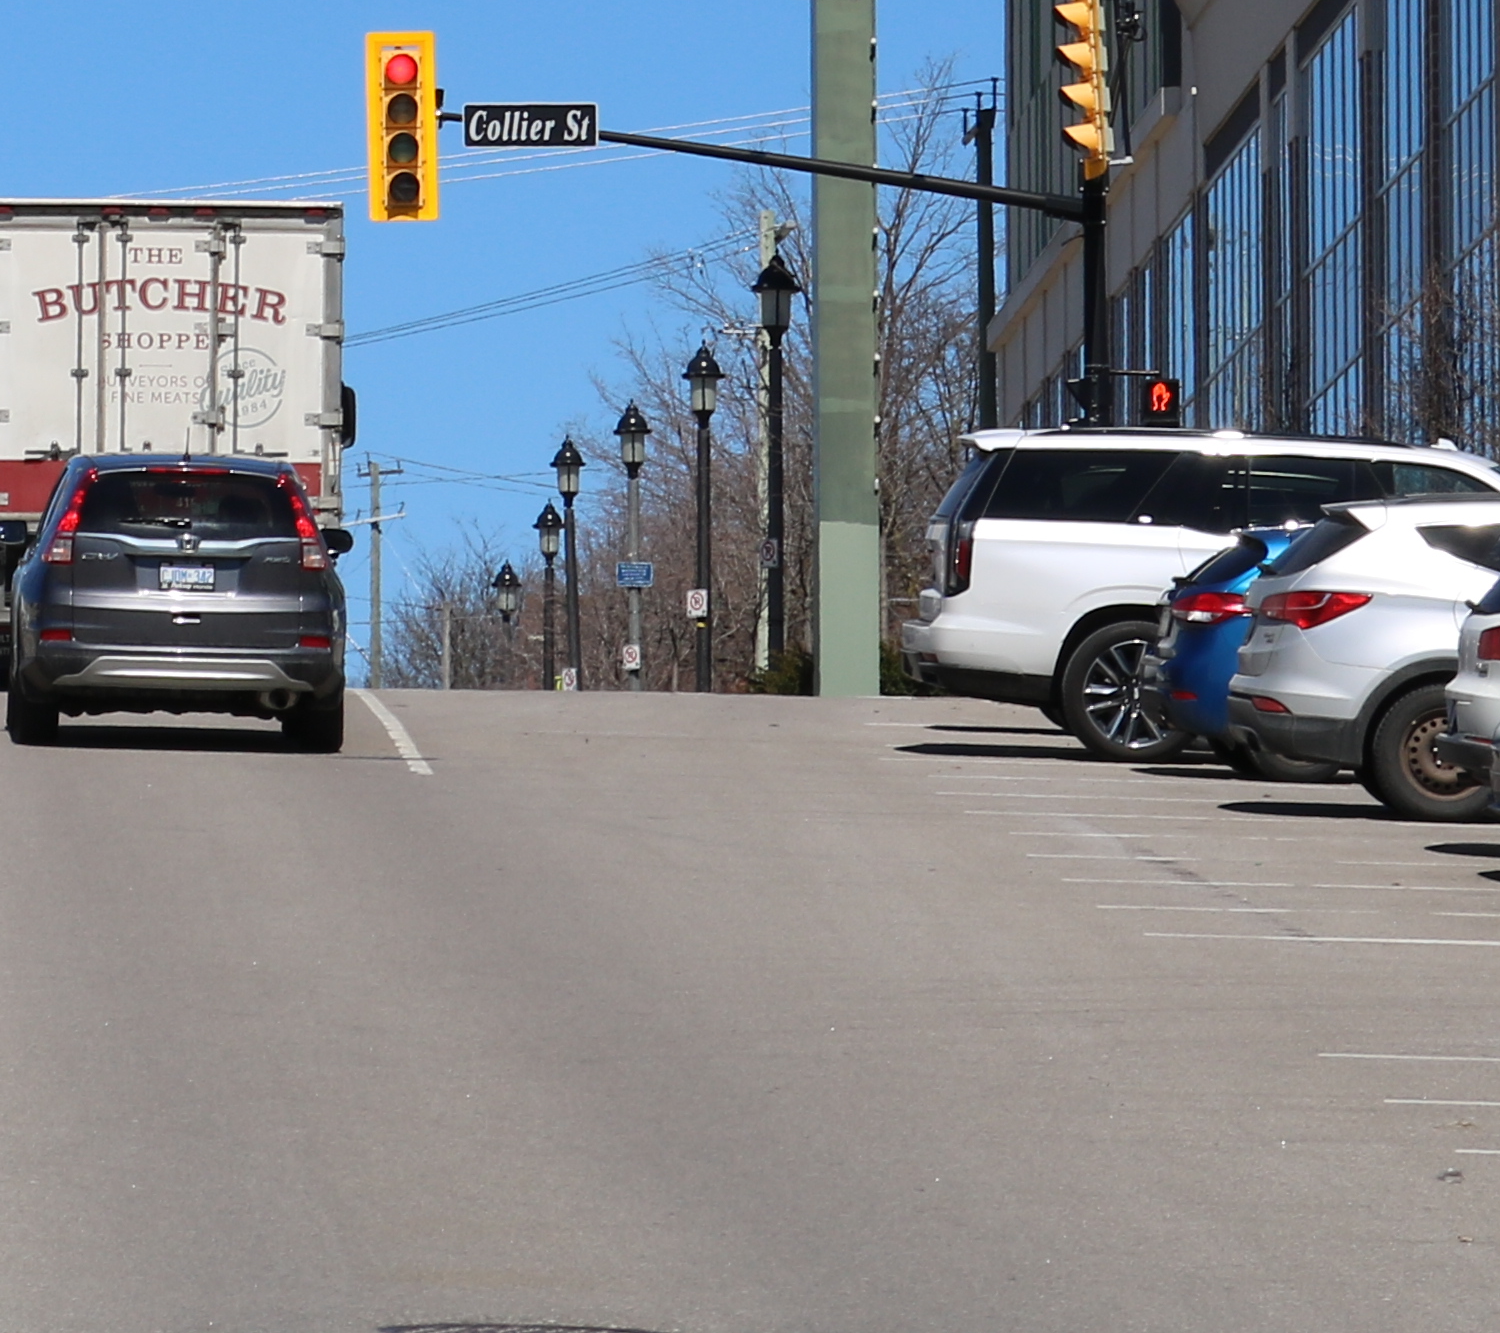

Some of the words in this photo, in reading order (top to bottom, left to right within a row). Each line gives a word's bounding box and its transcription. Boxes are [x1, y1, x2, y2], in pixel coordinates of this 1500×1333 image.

[469, 110, 556, 142] Collier
[563, 109, 591, 142] St
[129, 247, 183, 265] THE
[32, 277, 287, 326] BUTCHER
[102, 332, 210, 351] SHOPPE
[103, 375, 188, 387] UVEYORS
[111, 391, 145, 403] FNE
[151, 391, 200, 404] MEATS
[236, 399, 267, 418] 984
